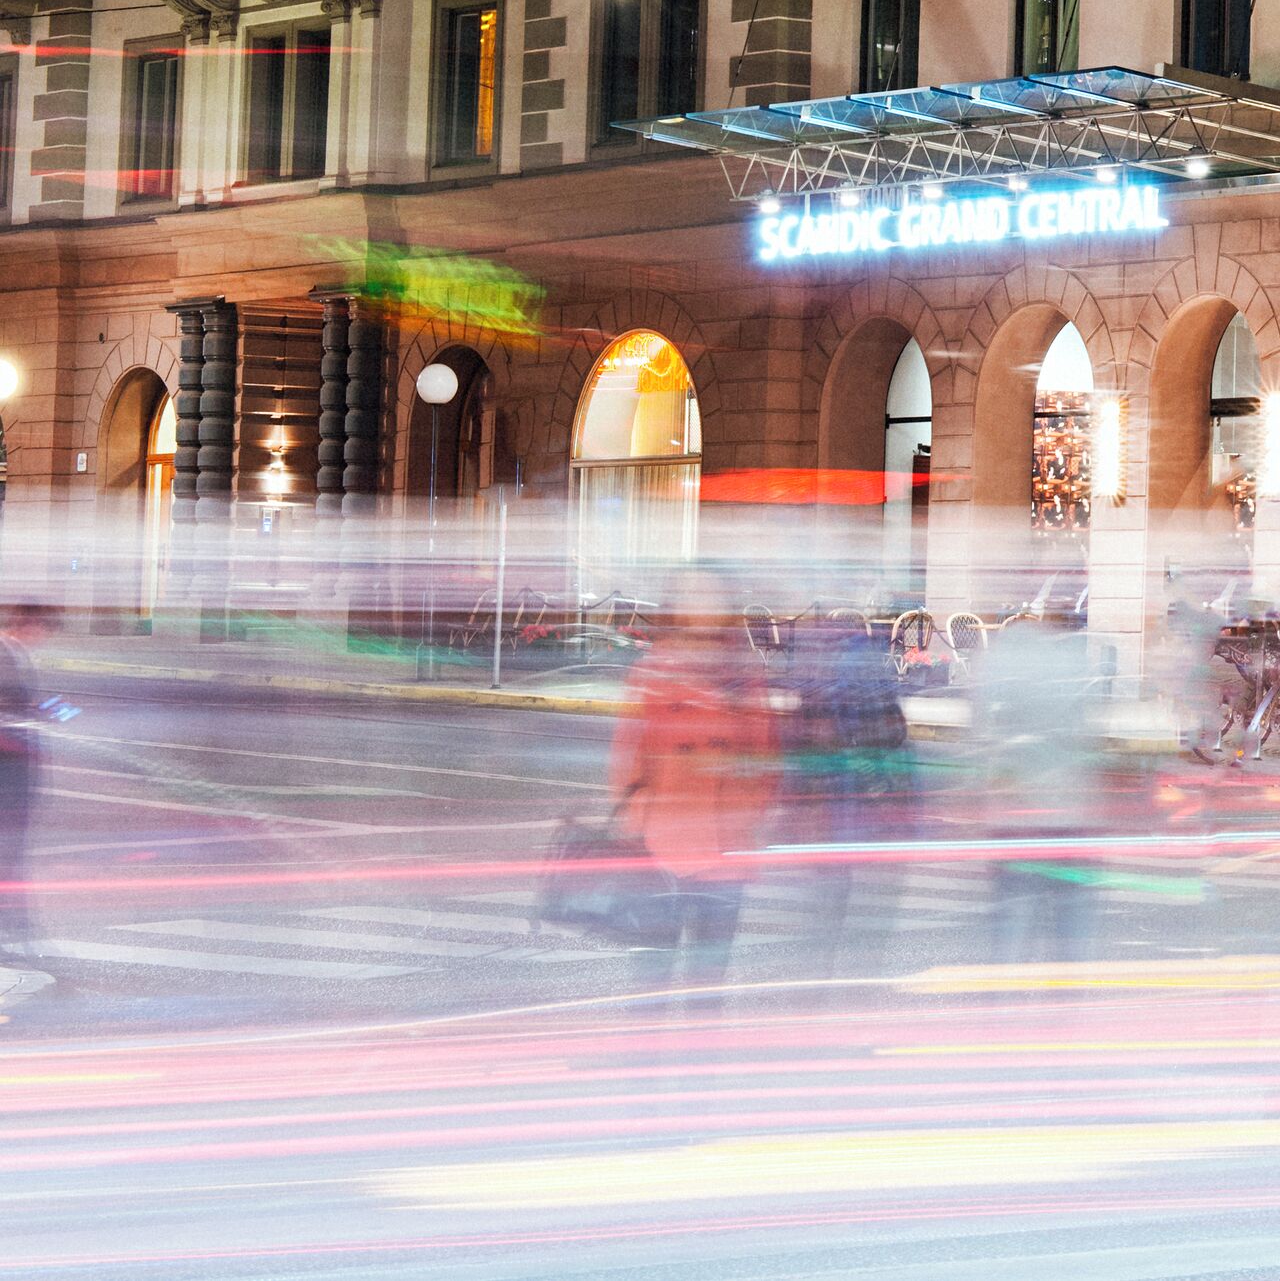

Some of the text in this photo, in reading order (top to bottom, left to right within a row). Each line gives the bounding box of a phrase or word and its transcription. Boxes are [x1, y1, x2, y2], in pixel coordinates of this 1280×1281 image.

[759, 207, 892, 259] SCANDIC
[899, 197, 1009, 248] GRAND
[1017, 185, 1169, 238] CENTRAL
